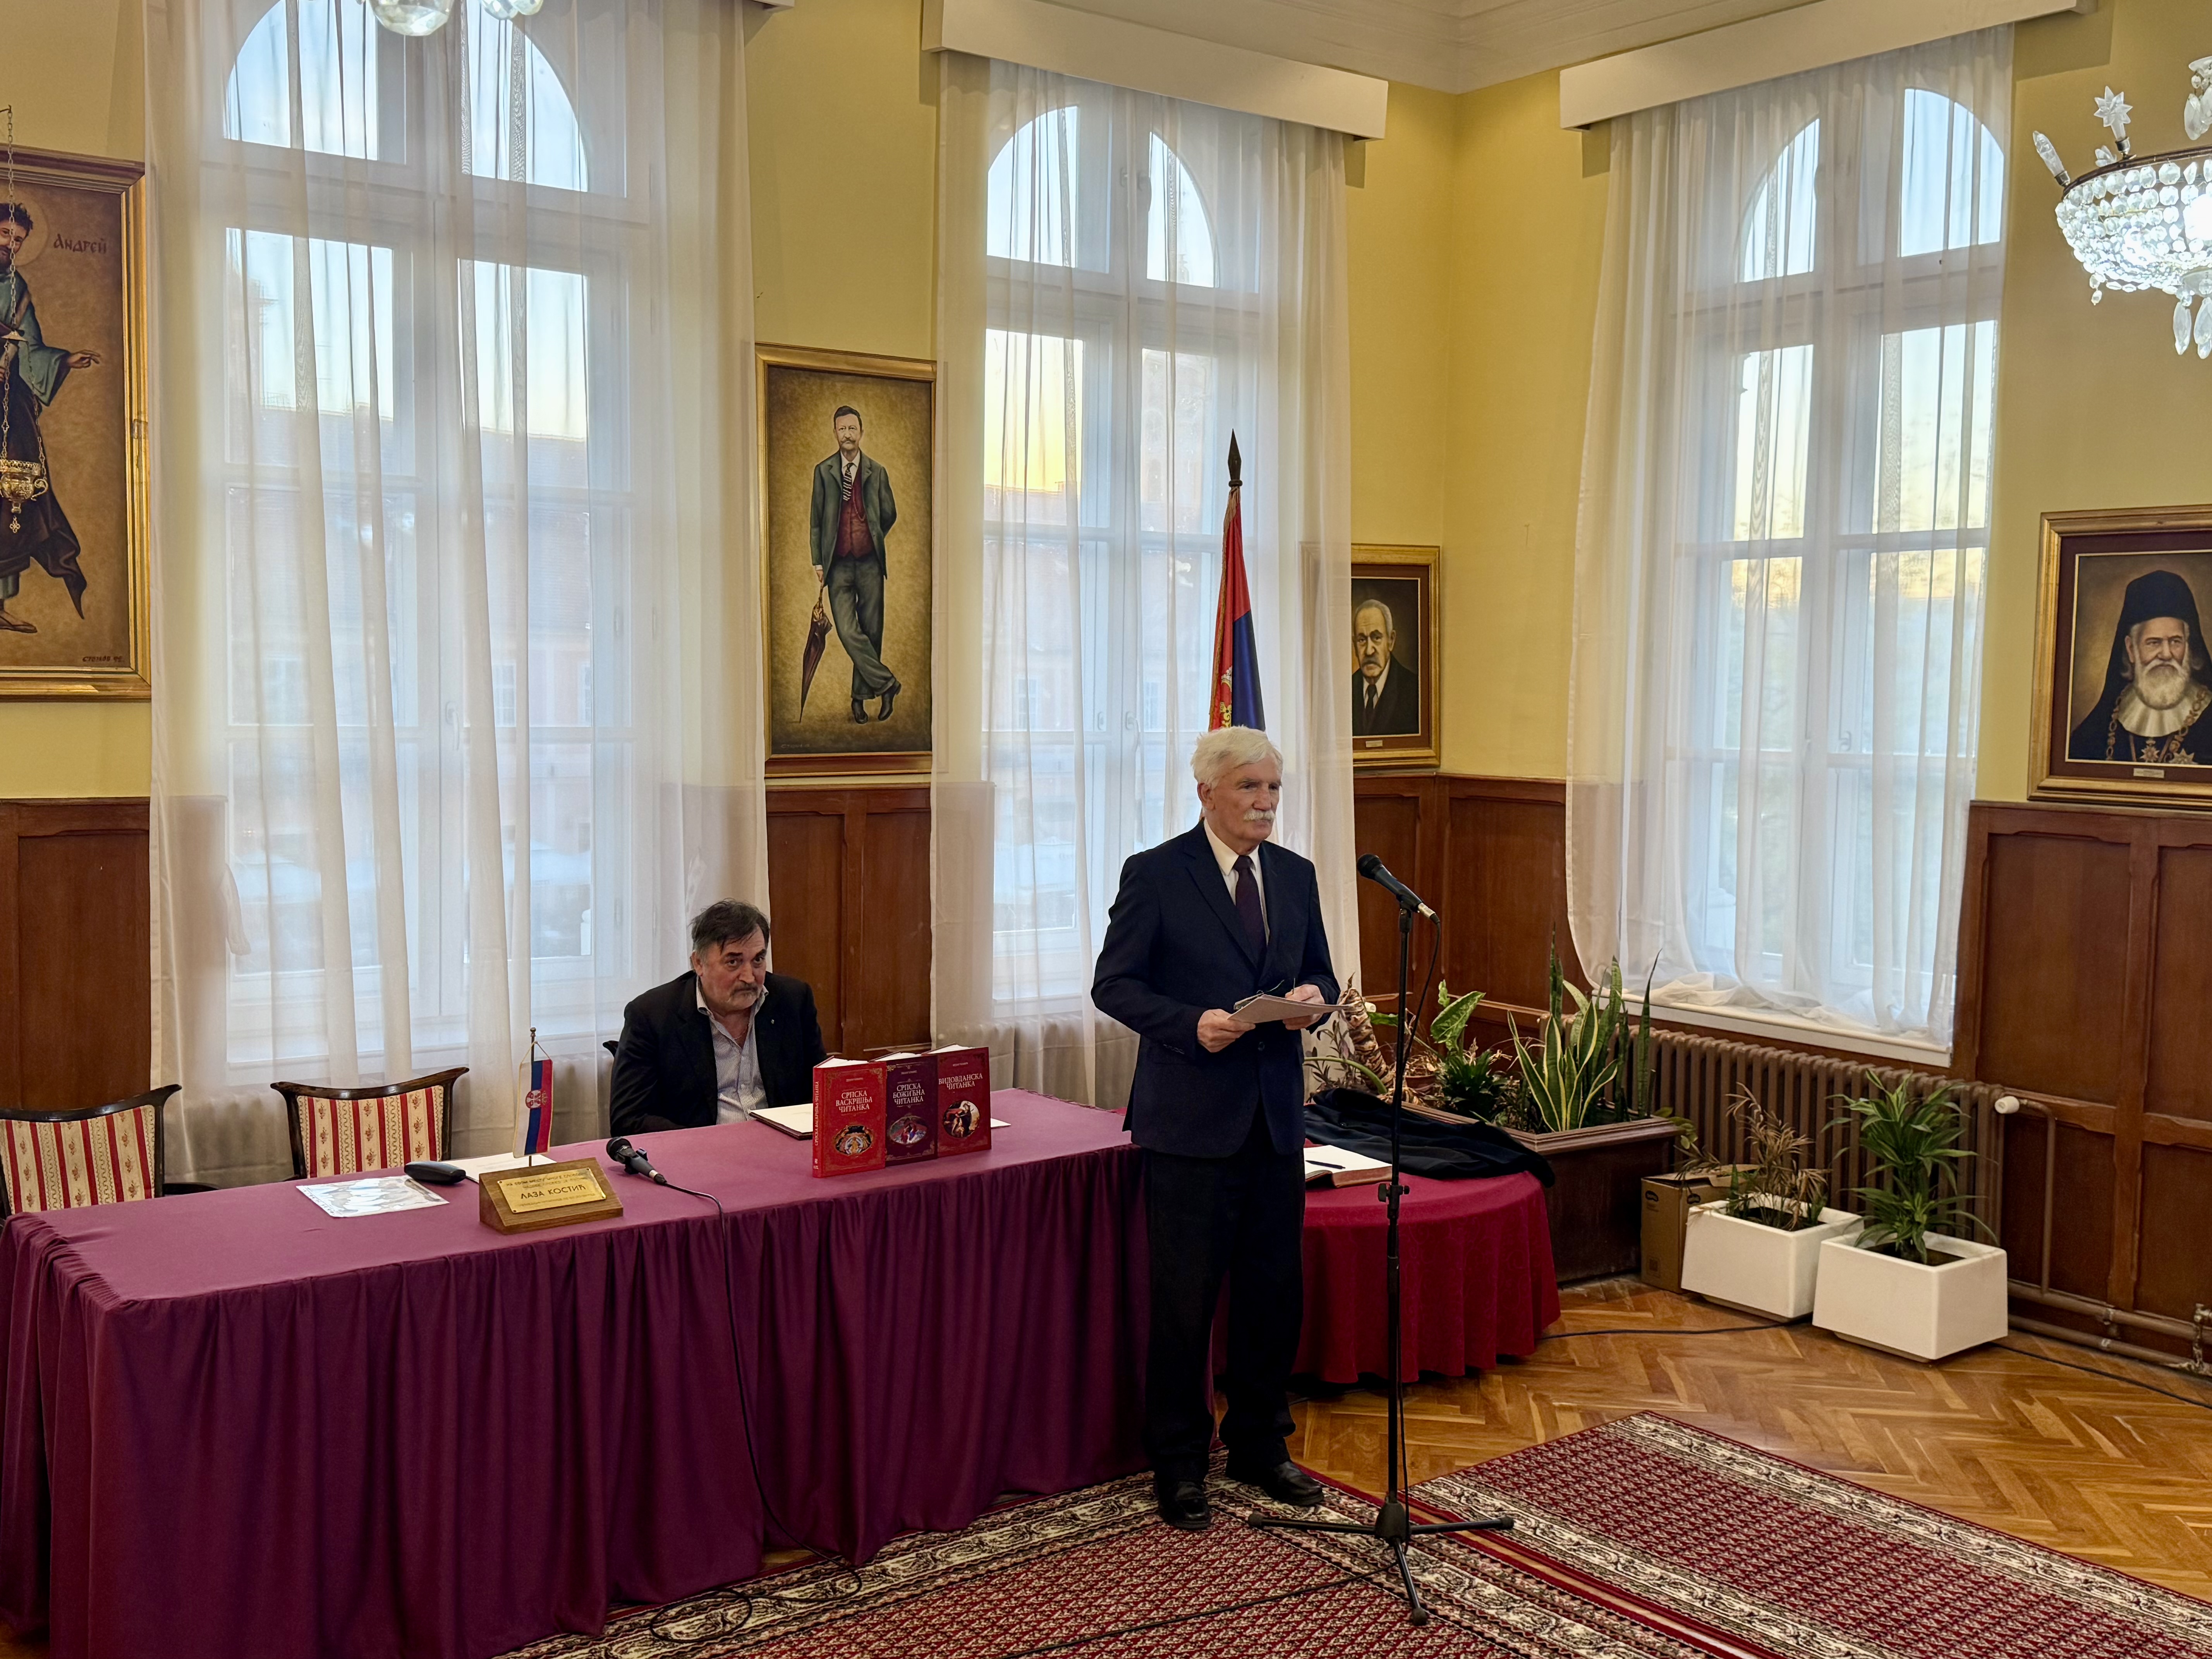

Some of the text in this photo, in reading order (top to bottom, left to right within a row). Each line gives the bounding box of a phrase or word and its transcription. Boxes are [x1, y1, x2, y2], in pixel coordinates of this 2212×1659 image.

[938, 1073, 983, 1085] ВИДОВДАНСКА
[897, 1083, 921, 1091] СРПСКА
[946, 1081, 975, 1090] ЧИТАНКА
[841, 1090, 867, 1099] СРПСКА
[836, 1096, 872, 1106] ВАСКРШЊА
[894, 1096, 924, 1105] ЧИТАНКА
[838, 1103, 870, 1113] ЧИТАНКА
[520, 1184, 586, 1199] ЛАЗА КОСТИЋ
